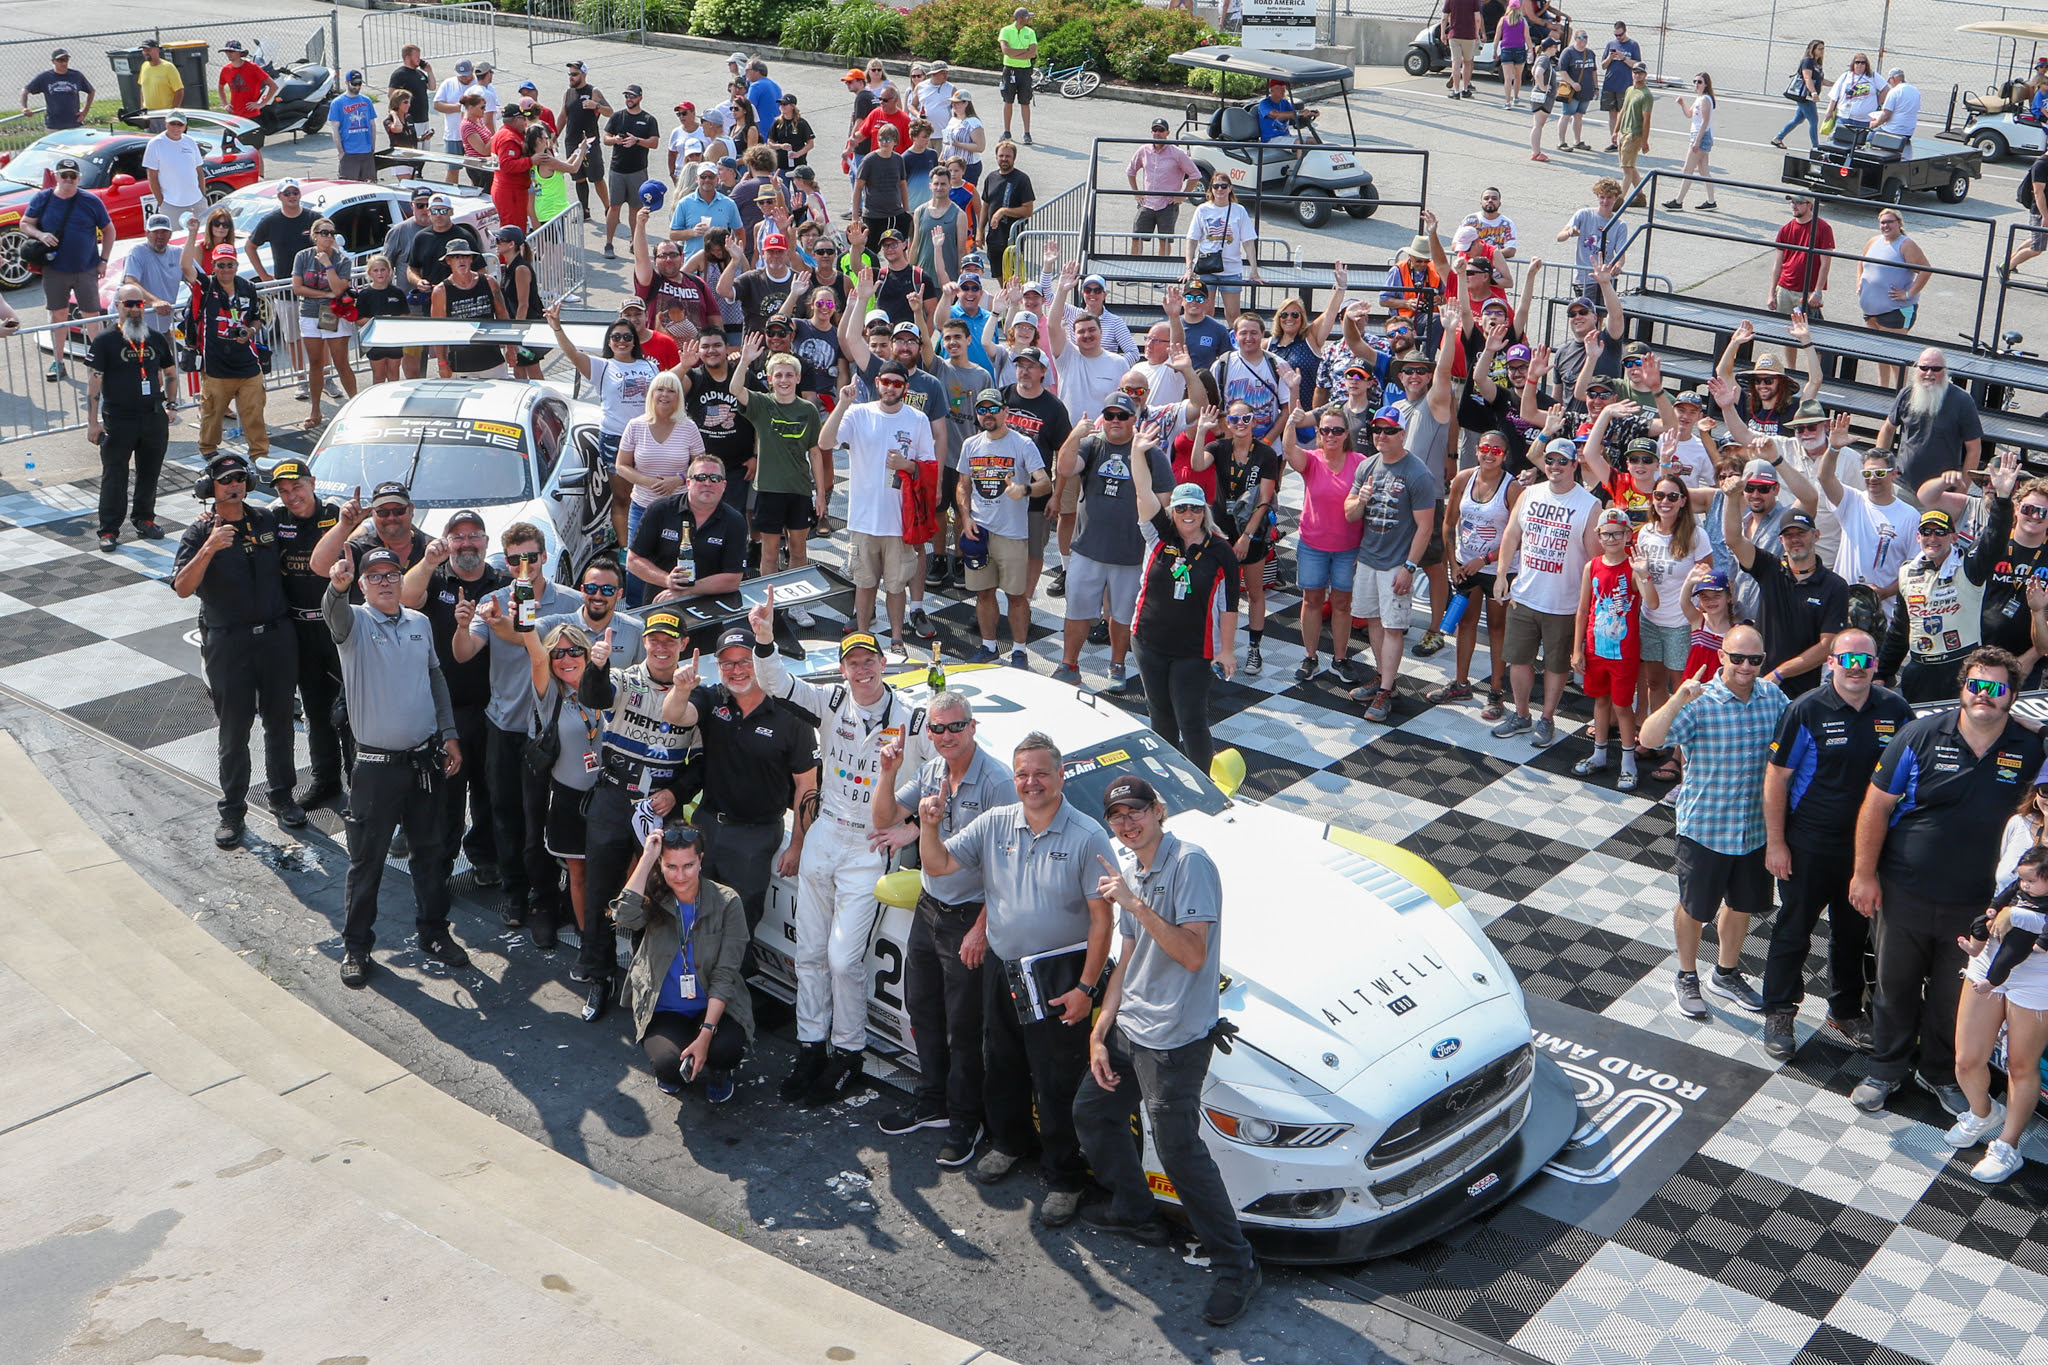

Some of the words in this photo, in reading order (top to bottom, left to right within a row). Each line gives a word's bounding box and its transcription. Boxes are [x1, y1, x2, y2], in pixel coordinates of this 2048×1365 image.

[1329, 153, 1348, 163] 607
[1230, 168, 1246, 181] 607
[658, 282, 700, 299] LEGENDS
[1510, 347, 1525, 357] ally
[700, 390, 716, 404] OLD
[456, 420, 471, 429] 10
[477, 423, 518, 436] PIRELLI
[331, 426, 520, 450] PORSCHE
[1527, 501, 1577, 524] SORRY
[1528, 522, 1549, 534] CAN'T
[1550, 527, 1570, 540] HEAR
[1525, 531, 1540, 546] YOU
[1541, 536, 1569, 551] OVER
[1530, 545, 1548, 556] SOUND
[1548, 549, 1557, 558] OF
[1557, 551, 1566, 559] MY
[1524, 553, 1564, 574] FREEDOM
[773, 584, 812, 600] CBD
[1908, 603, 1961, 617] Racing
[844, 635, 873, 648] PIRELLI
[625, 726, 677, 748] NORCOLD
[1139, 737, 1159, 751] 20
[830, 745, 877, 773] ALTWE
[1101, 752, 1127, 764] PIRELLI
[1321, 954, 1443, 1026] ALTWELL
[1392, 998, 1413, 1013] CBD
[1435, 1040, 1458, 1058] Ford
[1598, 1056, 1708, 1101] ROAD
[1475, 1173, 1497, 1188] SCCA
